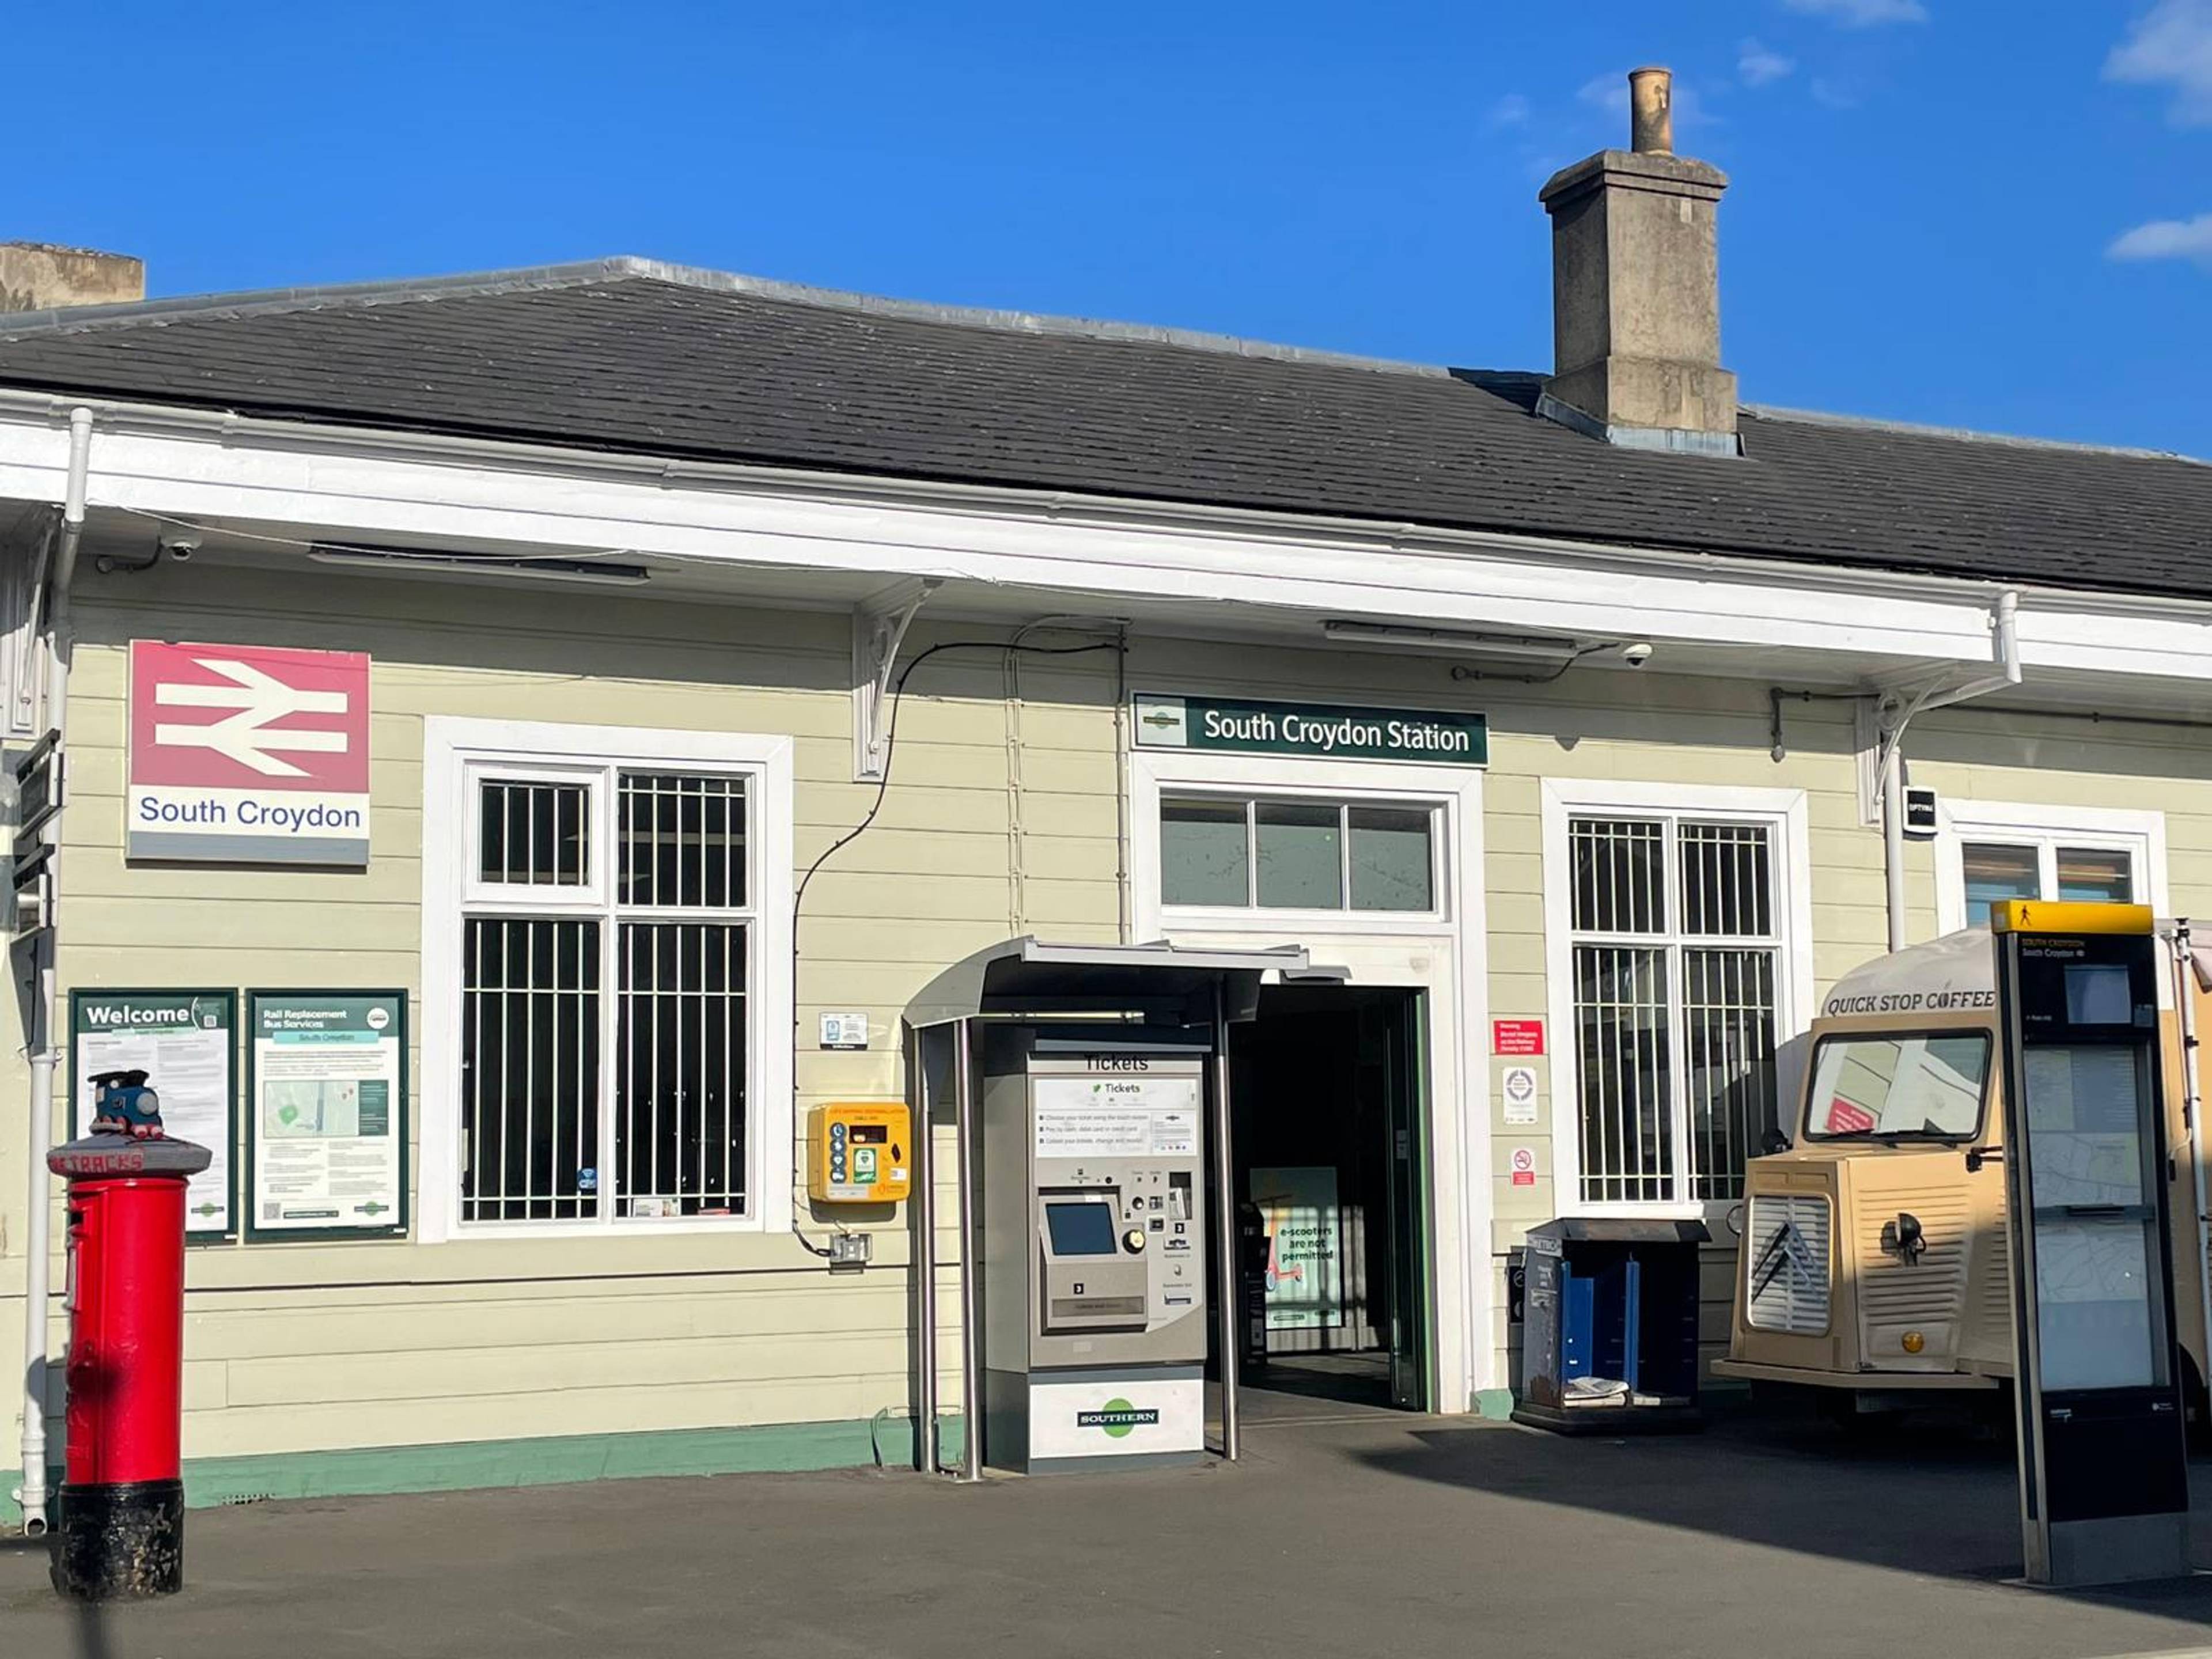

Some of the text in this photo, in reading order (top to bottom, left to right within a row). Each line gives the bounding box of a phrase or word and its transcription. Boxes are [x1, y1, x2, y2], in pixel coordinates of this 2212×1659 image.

[1205, 710, 1469, 751] South Croydon Station
[139, 797, 361, 832] South Croydon
[1828, 991, 1995, 1017] QUICK STOP COFFEE
[87, 1005, 189, 1024] Welcome
[264, 1010, 347, 1020] Rail Replacement
[264, 1020, 324, 1028] Bus Services
[1085, 1055, 1149, 1071] Tickets
[1105, 1084, 1141, 1093] Tickets
[1281, 1228, 1332, 1236] e-scooters
[1289, 1239, 1325, 1249] are not
[1282, 1250, 1333, 1263] permitted
[1081, 1413, 1156, 1423] SOUTHERN
